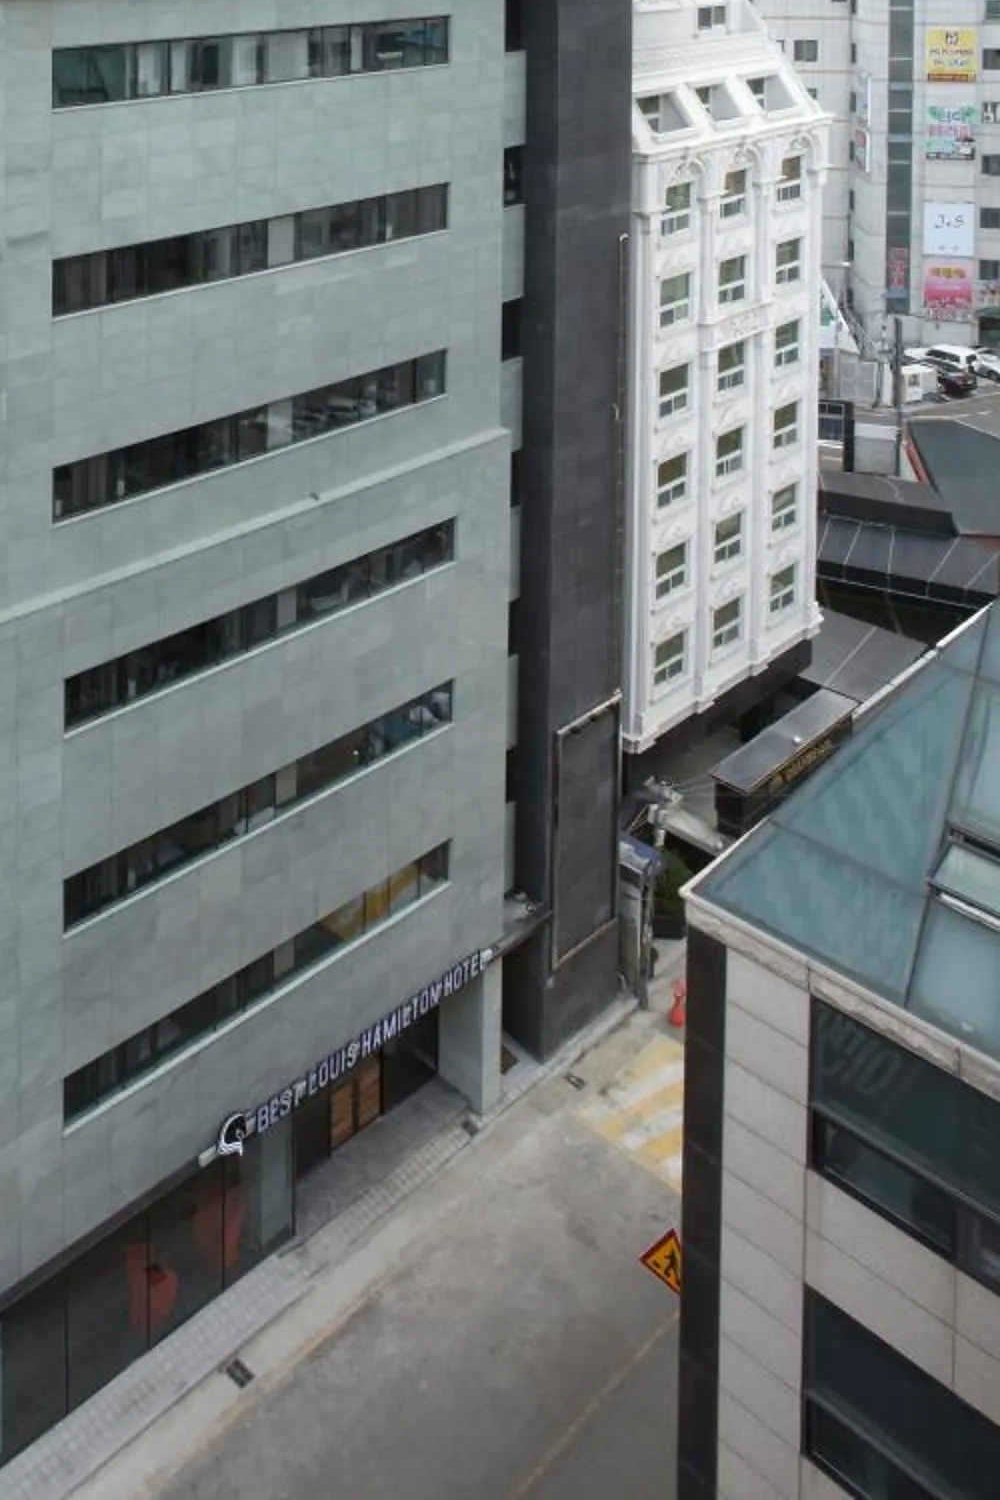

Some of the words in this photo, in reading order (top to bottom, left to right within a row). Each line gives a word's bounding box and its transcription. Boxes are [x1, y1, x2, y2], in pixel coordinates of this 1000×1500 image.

[257, 1080, 305, 1133] BEST
[308, 1042, 358, 1097] LOUIS
[361, 980, 441, 1058] HAMILTON
[443, 950, 488, 997] HOTEL
